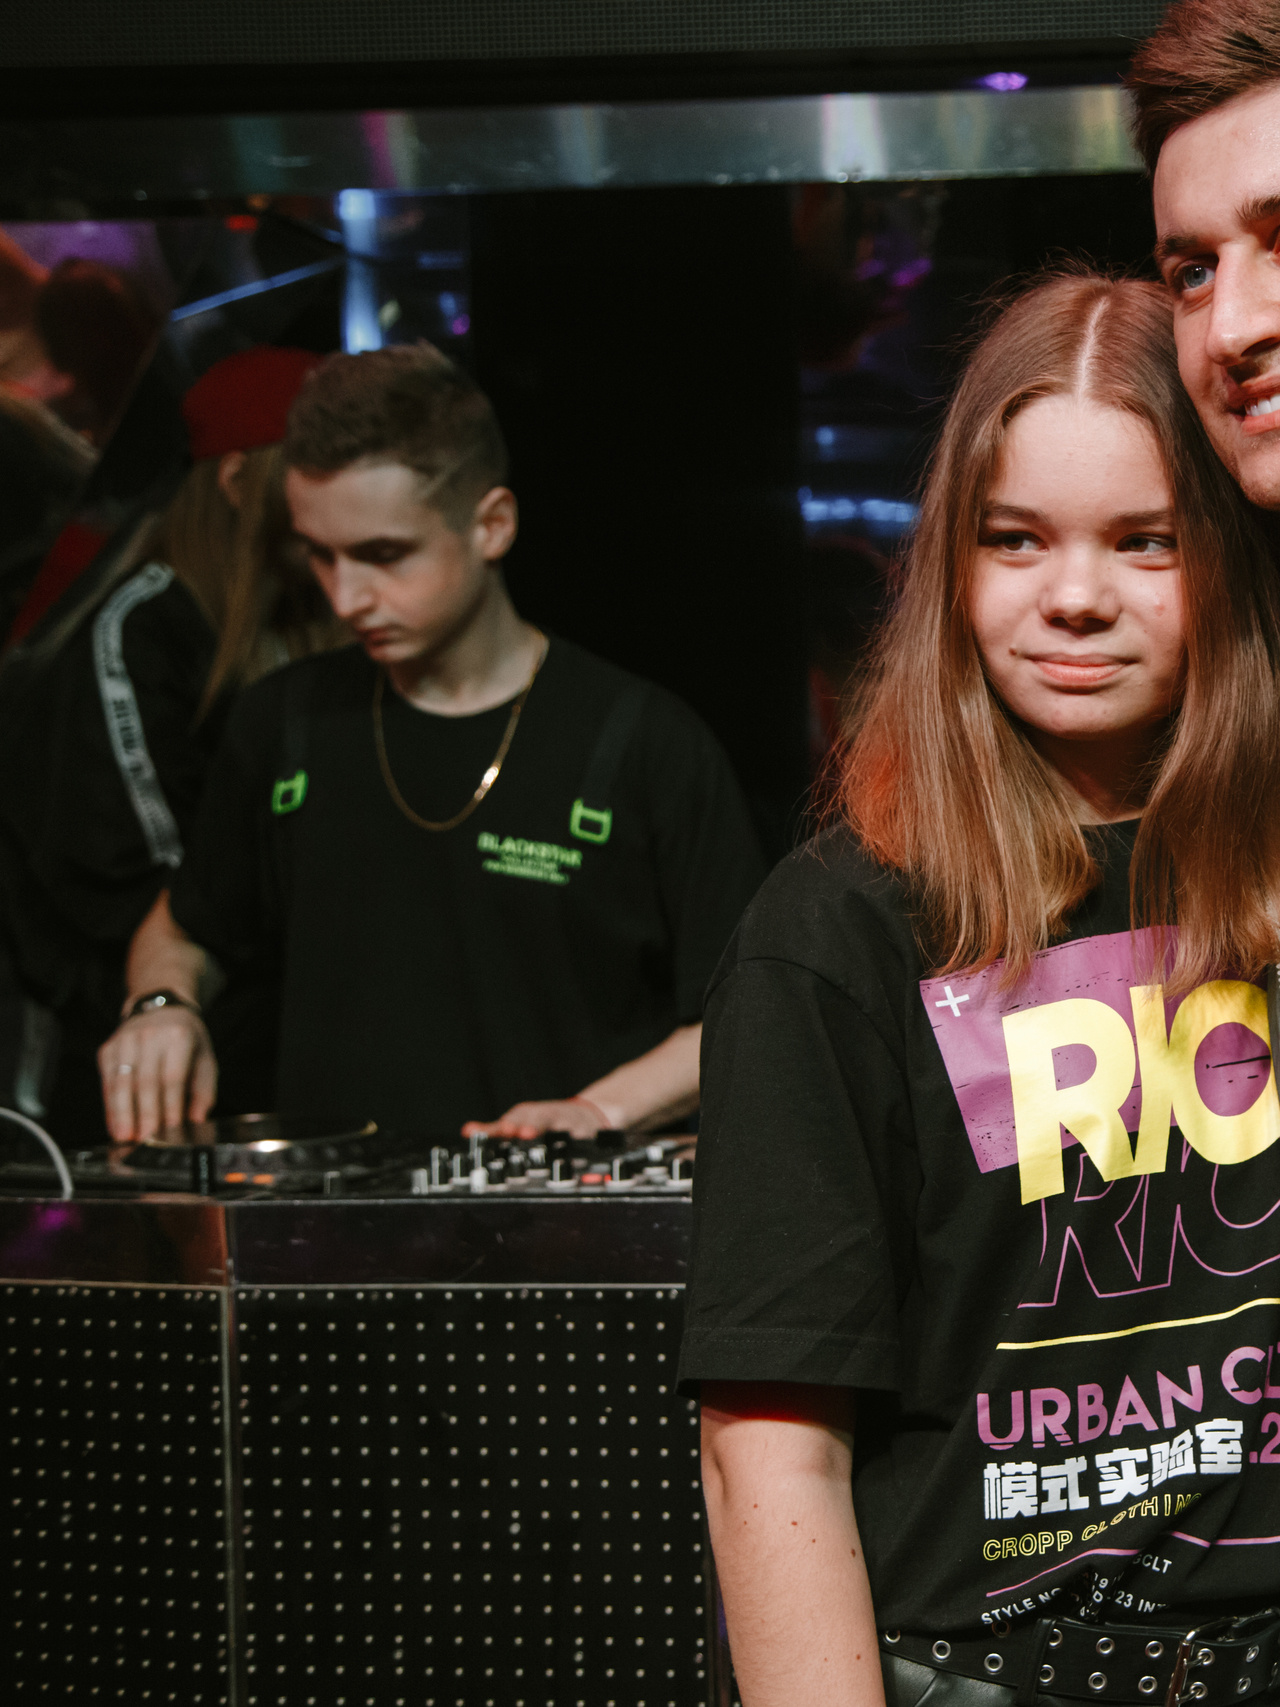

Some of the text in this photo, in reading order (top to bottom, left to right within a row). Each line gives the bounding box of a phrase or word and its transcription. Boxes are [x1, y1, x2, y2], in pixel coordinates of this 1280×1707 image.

[976, 1364, 1204, 1450] URBAN
[983, 1417, 1244, 1520] 模式实验室
[982, 1529, 1074, 1562] CROPP
[980, 1596, 1037, 1626] STYLE
